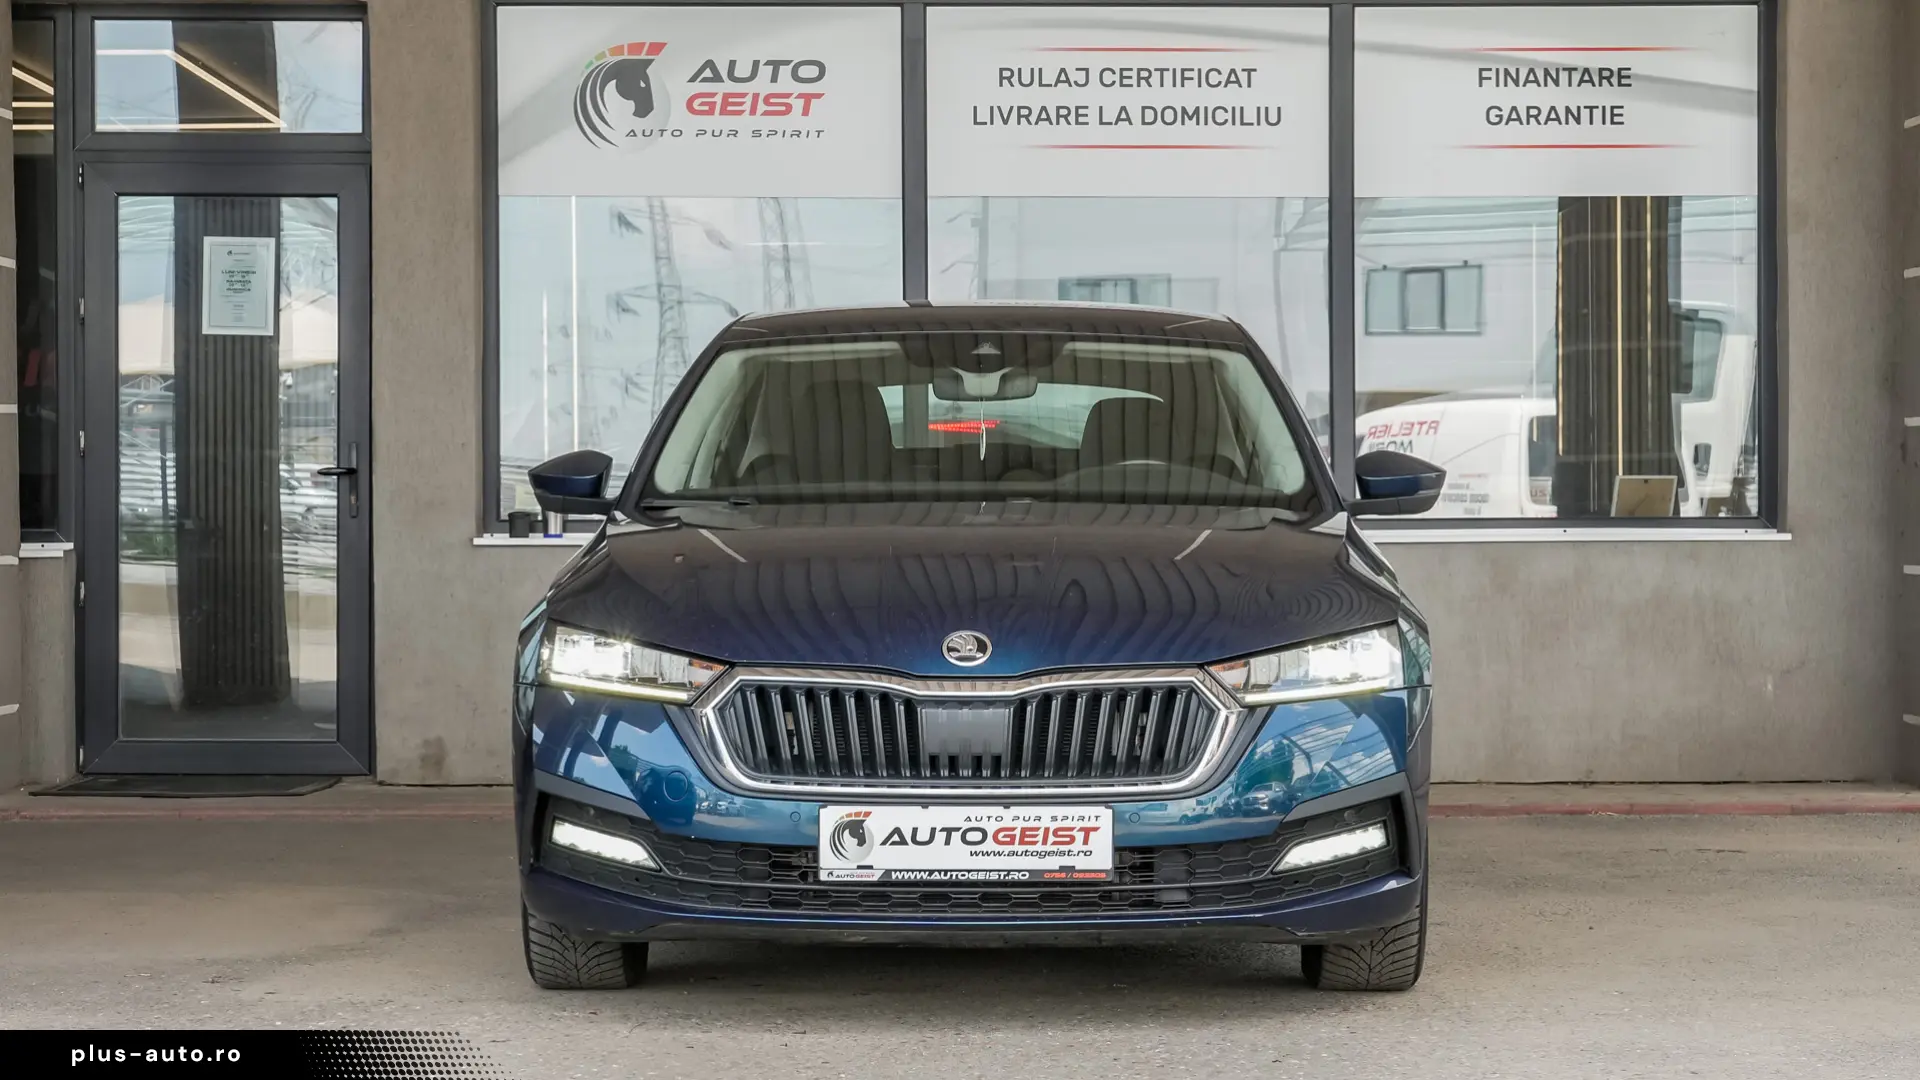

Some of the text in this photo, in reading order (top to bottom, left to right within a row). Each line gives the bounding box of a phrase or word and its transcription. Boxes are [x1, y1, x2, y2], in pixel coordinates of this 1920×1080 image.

[686, 58, 827, 84] AUTO
[998, 67, 1258, 88] RULAJ CERTIFICAT
[1478, 67, 1633, 88] FINANTARE
[685, 92, 826, 117] GEIST
[972, 105, 1283, 126] LIVRARE LA DOMICILIU
[1485, 105, 1625, 126] GARANTIE
[625, 128, 826, 139] AUTO PUR SPIRIT
[963, 815, 1101, 823] AUTO PUR SPIRIT
[969, 848, 1093, 860] www.autogeist.ro
[891, 871, 1030, 880] WWW.AUTOGEIST.RO
